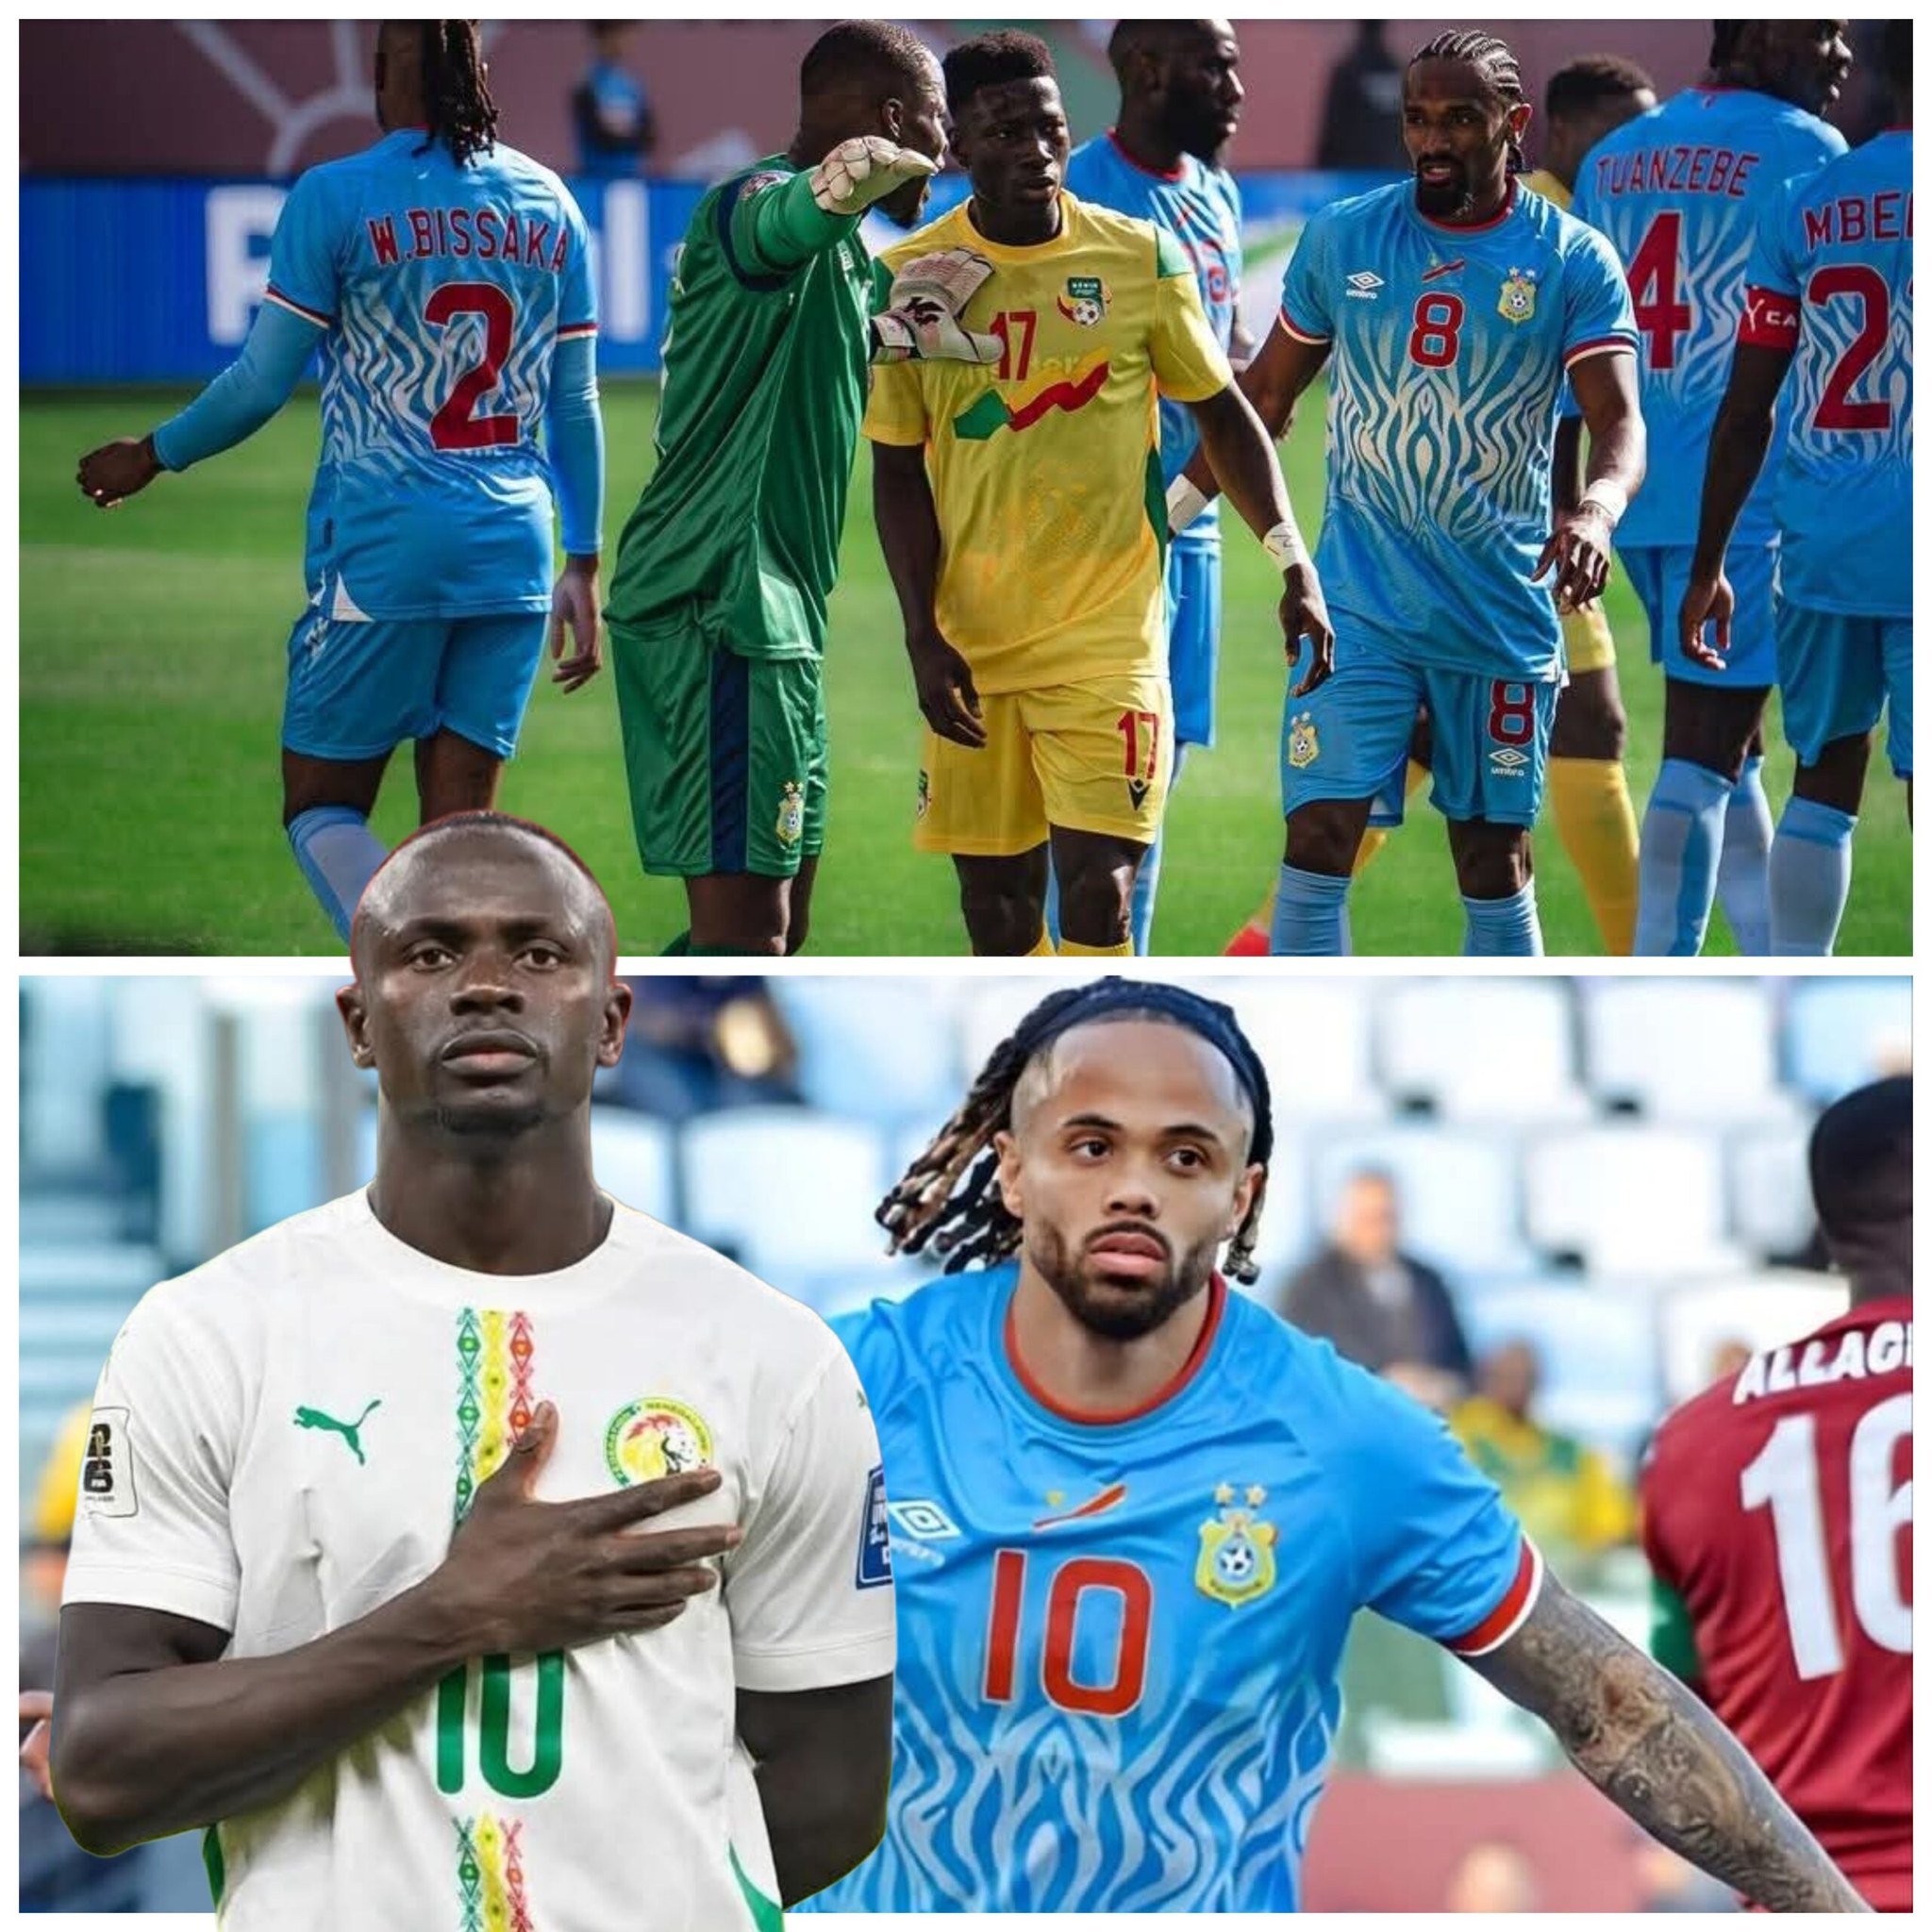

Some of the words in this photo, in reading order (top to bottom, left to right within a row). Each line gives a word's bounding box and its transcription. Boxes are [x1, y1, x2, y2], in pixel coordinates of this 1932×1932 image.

[1596, 145, 1760, 200] TUANZEBE
[366, 207, 568, 273] W.BISSAKA
[1625, 208, 1694, 371] 4
[423, 282, 520, 451] 2
[989, 308, 1038, 383] 17
[1408, 291, 1466, 370] 8
[1117, 710, 1160, 779] 17
[1487, 680, 1536, 746] 8
[1740, 1391, 1913, 1681] 16
[982, 1548, 1154, 1721] 10
[436, 1649, 566, 1801] 10
